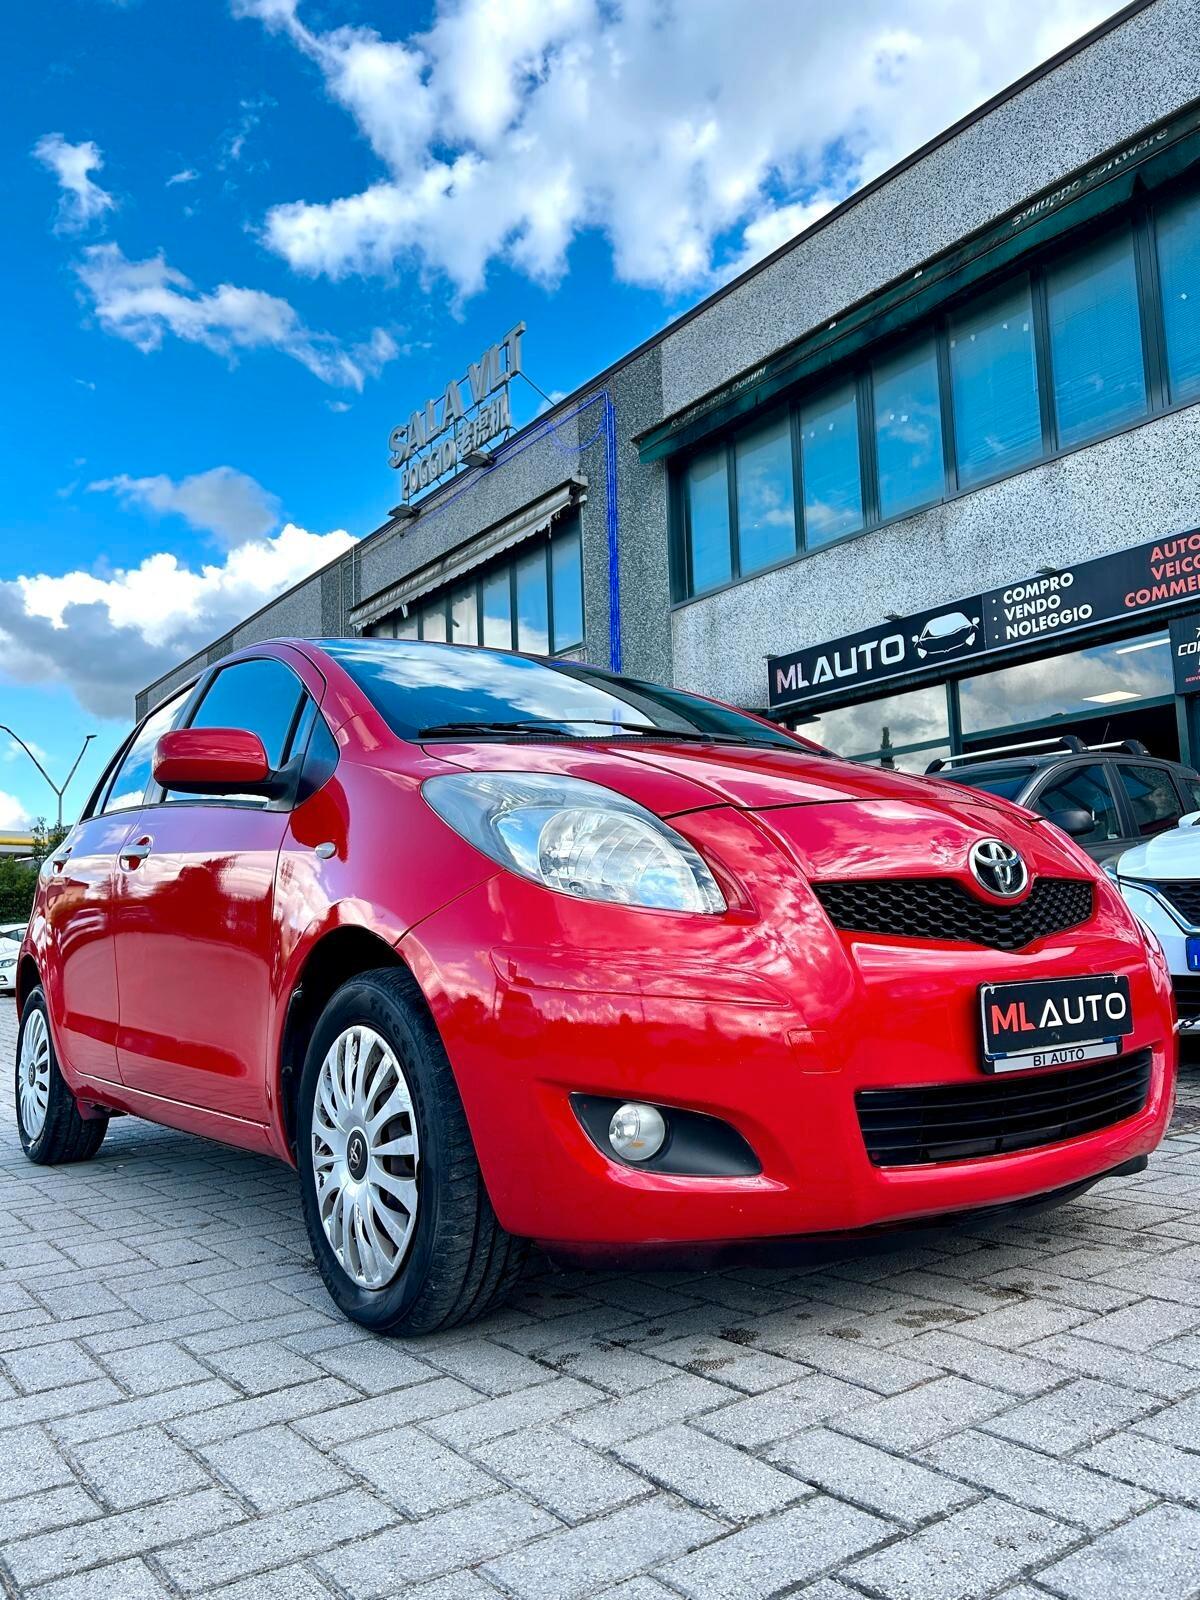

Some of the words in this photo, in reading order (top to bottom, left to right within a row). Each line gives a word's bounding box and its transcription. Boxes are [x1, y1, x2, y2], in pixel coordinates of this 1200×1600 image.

[388, 379, 464, 469] SALA
[467, 320, 526, 404] VLT
[401, 438, 457, 500] POGGIO
[1003, 572, 1074, 605] COMPRO
[1124, 575, 1200, 608] COMME
[1003, 594, 1061, 621] VENDO
[1005, 604, 1093, 640] NOLEGGIO
[1033, 1055, 1046, 1067] BI
[1050, 1048, 1085, 1064] AUTO
